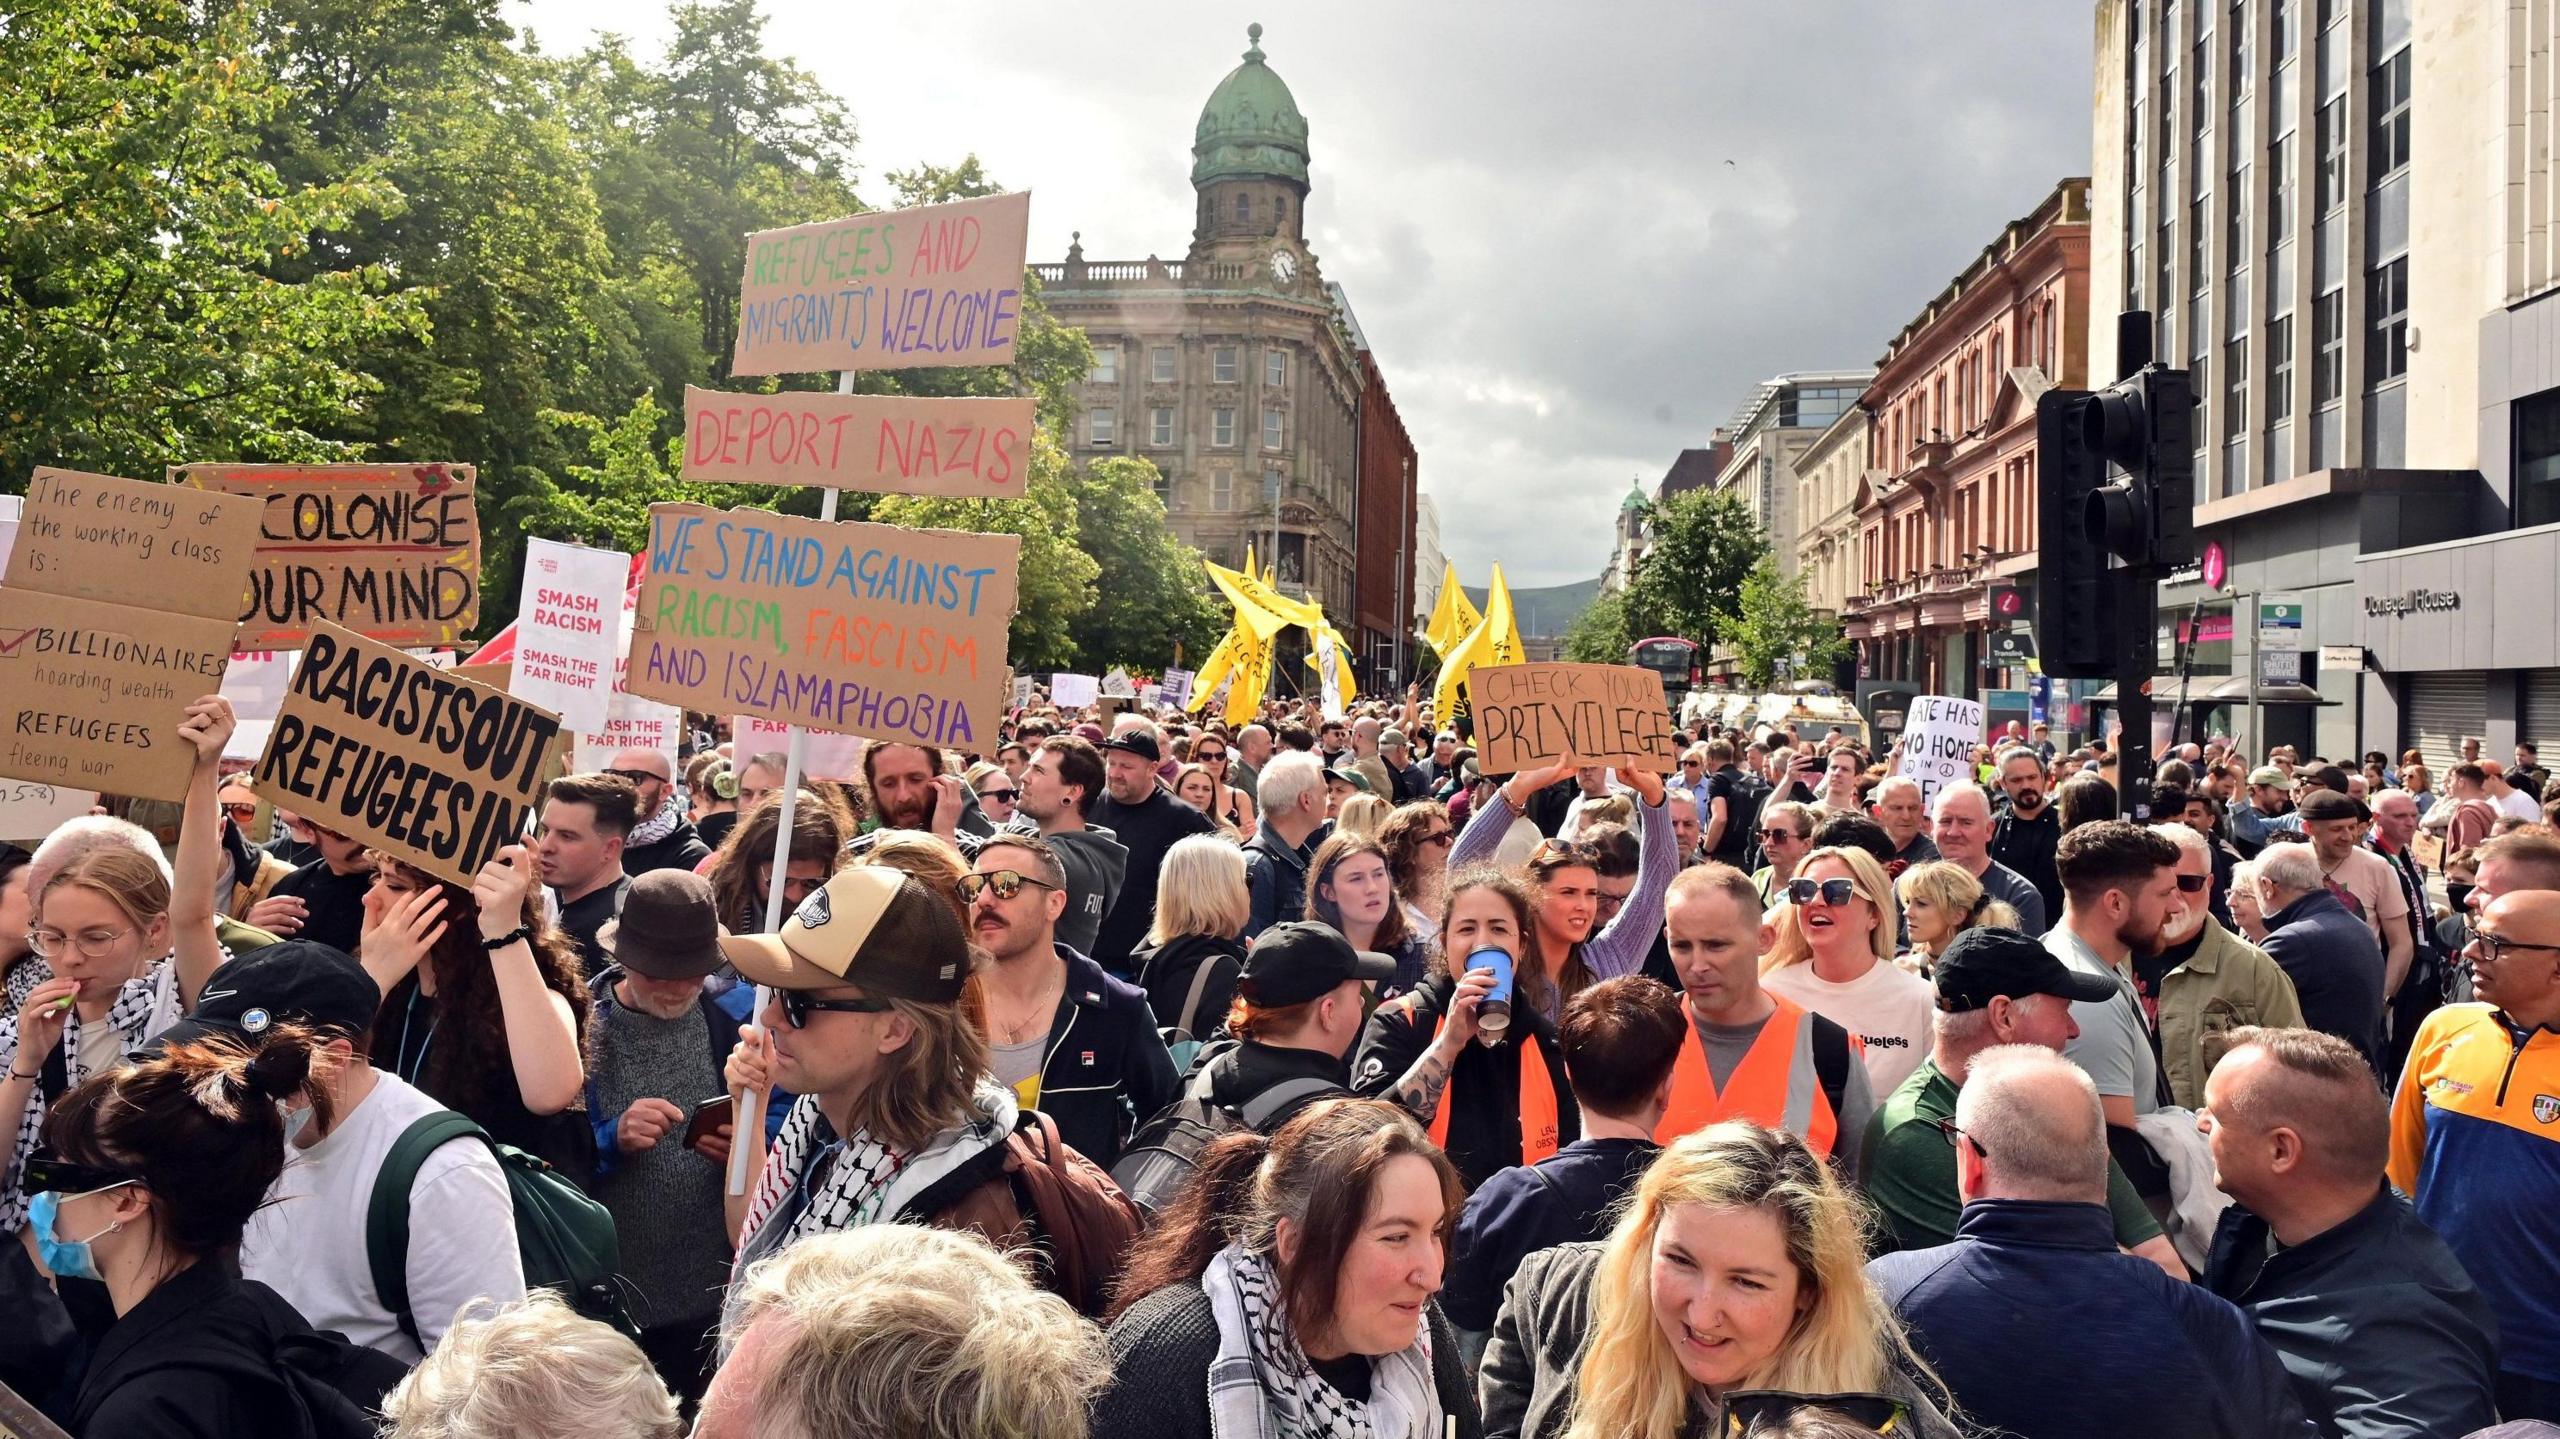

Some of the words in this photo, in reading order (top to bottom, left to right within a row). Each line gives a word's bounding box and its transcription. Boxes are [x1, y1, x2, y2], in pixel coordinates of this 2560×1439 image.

[752, 223, 896, 289] REFUGEES
[910, 215, 982, 279] AND
[744, 286, 878, 353] MIGRANTS
[880, 287, 1019, 354] WELCOME
[691, 406, 855, 472] DEPORT
[876, 418, 1018, 485] NAZIS
[37, 475, 83, 508] The
[95, 490, 176, 530] enemy
[199, 504, 222, 526] of
[250, 489, 471, 547] COLONISE
[30, 513, 62, 539] the
[74, 525, 154, 560] working
[170, 536, 223, 565] class
[29, 548, 60, 572] is:
[651, 514, 703, 576] WE
[706, 522, 825, 588] STAND
[826, 544, 996, 617] AGAINST
[237, 565, 327, 624] OUR
[336, 564, 472, 625] MIND
[536, 588, 599, 613] SMASH
[2416, 589, 2457, 609] House
[533, 608, 603, 635] RACISM
[654, 583, 789, 657] RACISM,
[804, 607, 979, 681] FASCISM
[34, 627, 229, 677] BILLIONAIRES
[522, 648, 568, 669] SMASH
[571, 658, 599, 676] THE
[2263, 660, 2298, 669] SHUTTLE
[2270, 652, 2299, 661] CRUISE
[34, 661, 113, 704] hoarding
[120, 680, 177, 701] wealth
[523, 664, 551, 682] FAR
[554, 673, 597, 690] RIGHT
[1486, 670, 1589, 703] CHECK
[1599, 669, 1666, 708] YOUR
[2265, 668, 2299, 677] SERVICE
[646, 641, 707, 688] AND
[722, 650, 974, 744] ISLAMAPHOBIA
[15, 709, 152, 749] REFUGEES
[607, 719, 632, 733] ASH
[635, 719, 663, 733] THE
[751, 719, 789, 734] FAR
[1913, 698, 1942, 723] ATE
[1945, 702, 1980, 727] HAS
[586, 734, 615, 748] FAR
[619, 735, 663, 749] RIGHT
[1482, 700, 1673, 767] PRIVILEGE
[1902, 733, 1925, 755] NO
[1931, 734, 1975, 762] HOME
[8, 742, 70, 777] fleeing
[81, 757, 115, 777] war
[1920, 759, 1933, 769] IN
